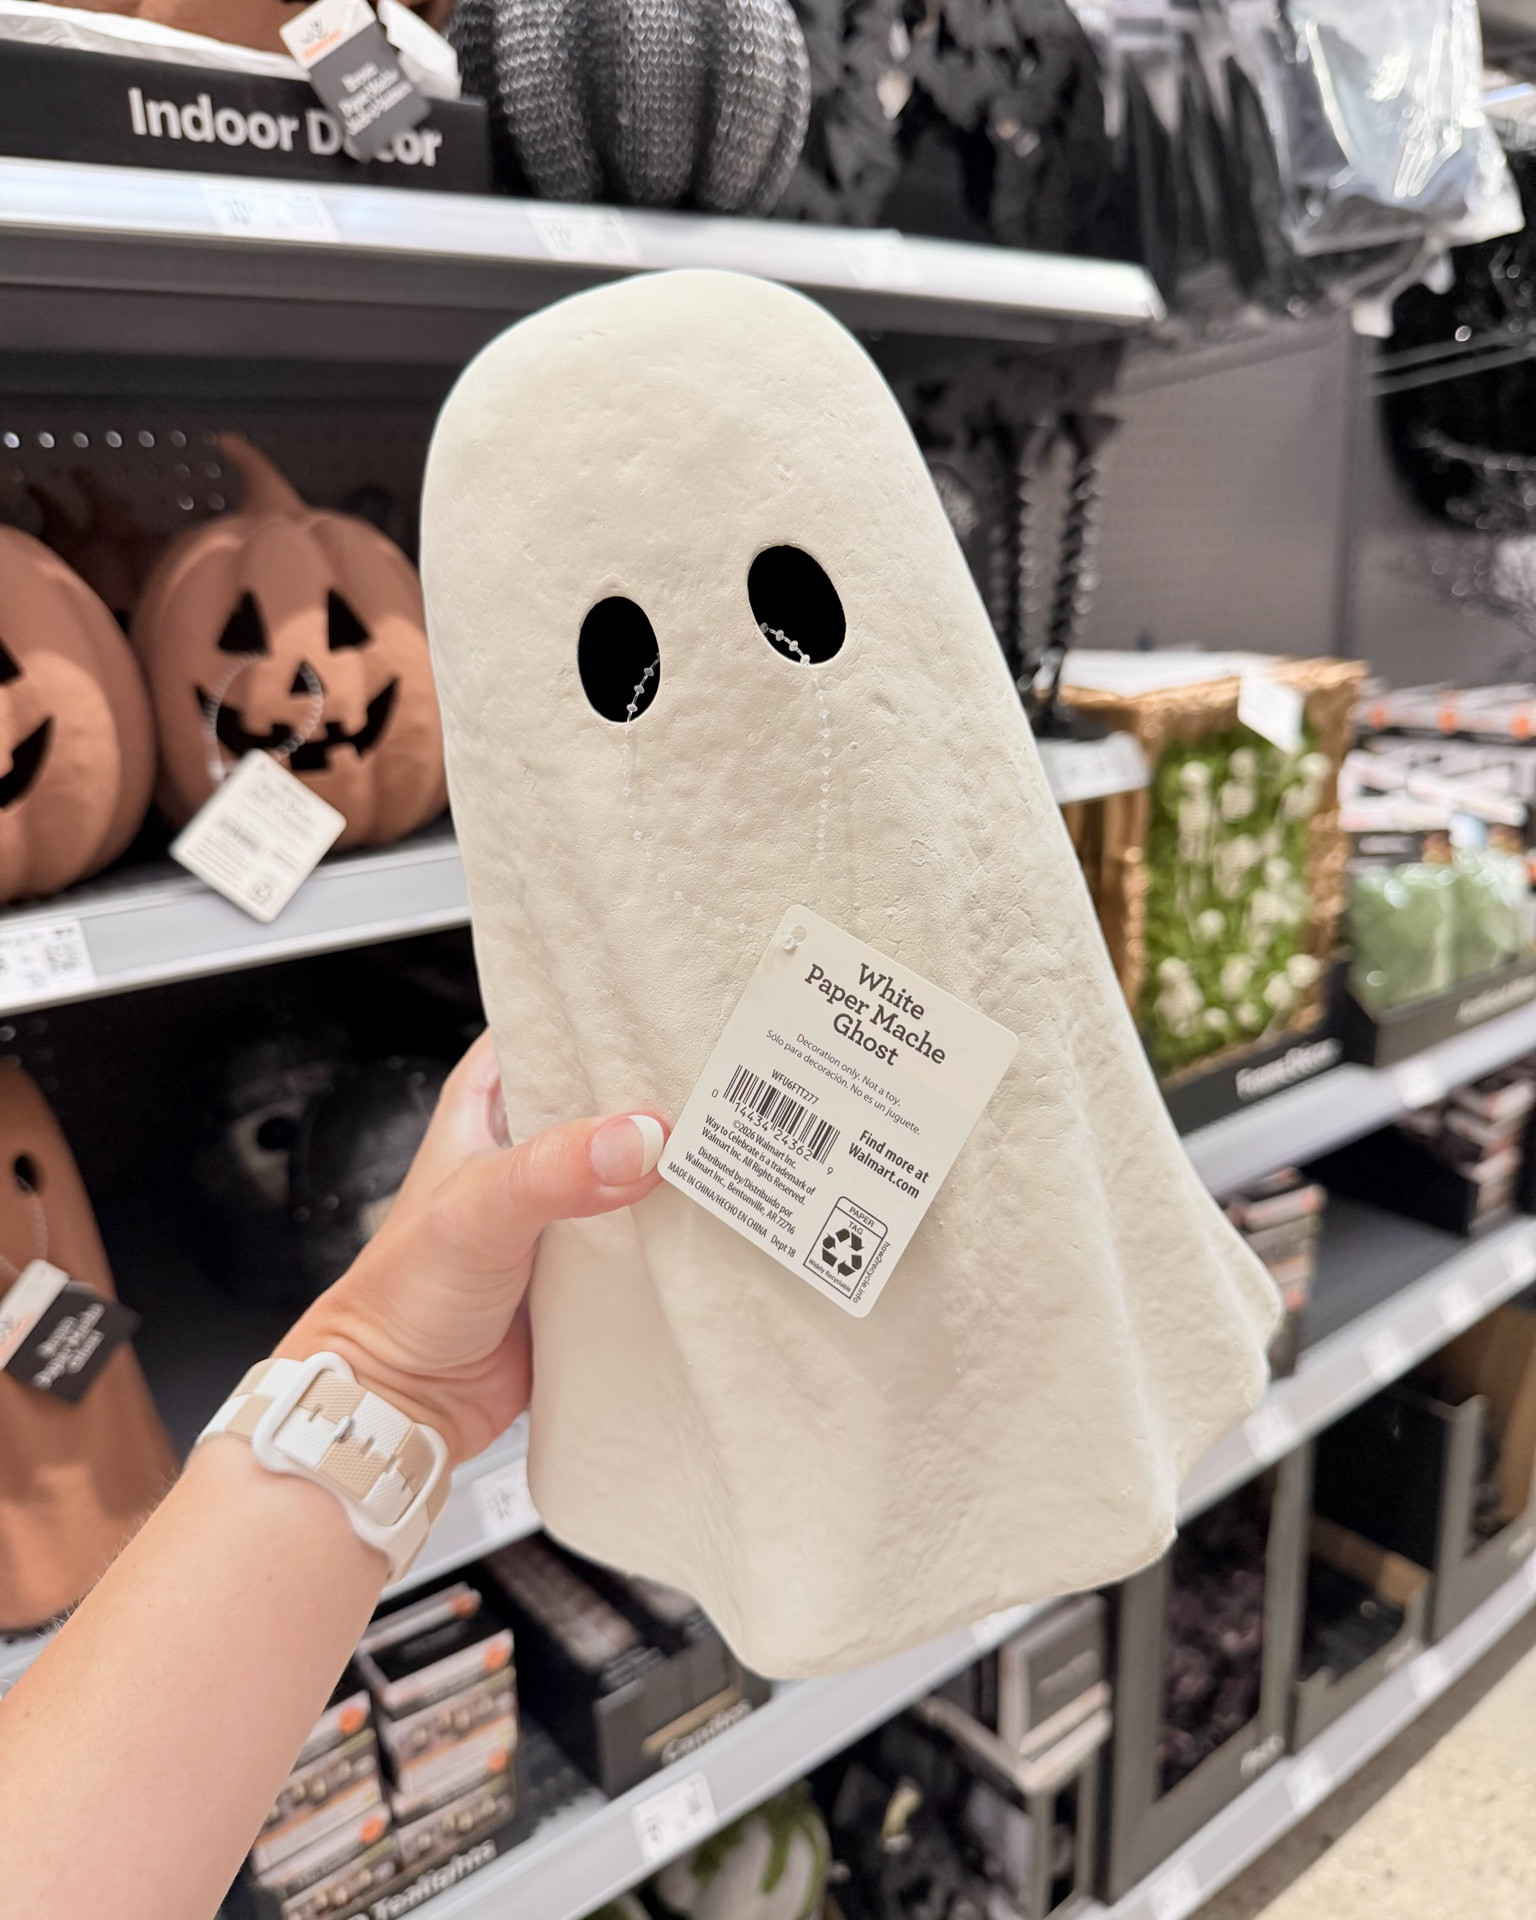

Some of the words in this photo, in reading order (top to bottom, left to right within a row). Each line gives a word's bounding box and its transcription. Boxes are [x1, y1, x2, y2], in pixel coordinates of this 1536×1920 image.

[128, 87, 300, 152] Indoor
[305, 107, 443, 167] Dor
[804, 963, 870, 1016] Paper
[869, 1003, 946, 1065] Mache
[858, 962, 925, 1020] White
[796, 1033, 841, 1067] Decoration
[841, 1063, 861, 1081] only.
[862, 1075, 879, 1092] Not
[878, 1087, 885, 1096] a
[885, 1090, 901, 1107] toy.
[833, 1012, 899, 1066] Ghost
[766, 1029, 785, 1046] Sólo
[783, 1042, 803, 1059] para
[803, 1053, 849, 1089] decoración.
[850, 1083, 863, 1097] No
[863, 1093, 873, 1104] es
[874, 1100, 886, 1112] un
[884, 1107, 921, 1136] juguete.
[701, 1126, 731, 1153] Walmart
[730, 1147, 742, 1162] Inc.
[741, 1155, 753, 1168] All
[751, 1161, 775, 1183] Rights
[773, 1176, 806, 1206] Reserved.
[705, 1114, 719, 1132] Way
[720, 1126, 728, 1136] to
[728, 1131, 760, 1158] Celebrate
[759, 1151, 765, 1162] is
[765, 1157, 771, 1166] a
[770, 1159, 807, 1191] trademark
[806, 1186, 817, 1196] of
[711, 1088, 719, 1098] 0
[734, 1102, 768, 1132] 14434
[773, 1128, 813, 1162] 24362
[826, 1166, 834, 1176] 9
[732, 1119, 756, 1140] ©2026
[755, 1133, 785, 1158] Walmart
[785, 1154, 797, 1170] Inc.
[859, 1129, 887, 1155] Find
[884, 1148, 915, 1174] more
[914, 1169, 930, 1184] at
[685, 1151, 713, 1178] Walmart
[712, 1172, 726, 1188] Inc.,
[727, 1181, 766, 1216] Bentonville,
[766, 1210, 778, 1222] AR
[776, 1216, 797, 1235] 72716
[698, 1146, 738, 1178] Distributed
[733, 1170, 781, 1210] by/Distribuido
[778, 1205, 794, 1219] por
[848, 1141, 920, 1199] Walmart.com
[667, 1161, 689, 1181] MADE
[686, 1175, 697, 1186] IN
[694, 1180, 739, 1216] CHINA/HECHO
[736, 1211, 748, 1223] EN
[746, 1217, 768, 1238] CHINA
[770, 1234, 789, 1252] Dept
[787, 1246, 797, 1258] 18
[848, 1206, 876, 1228] PAPER
[848, 1220, 864, 1236] TAG
[808, 1258, 825, 1274] Widely
[824, 1268, 852, 1293] Recyclable
[852, 1240, 891, 1304] how2recycle.info
